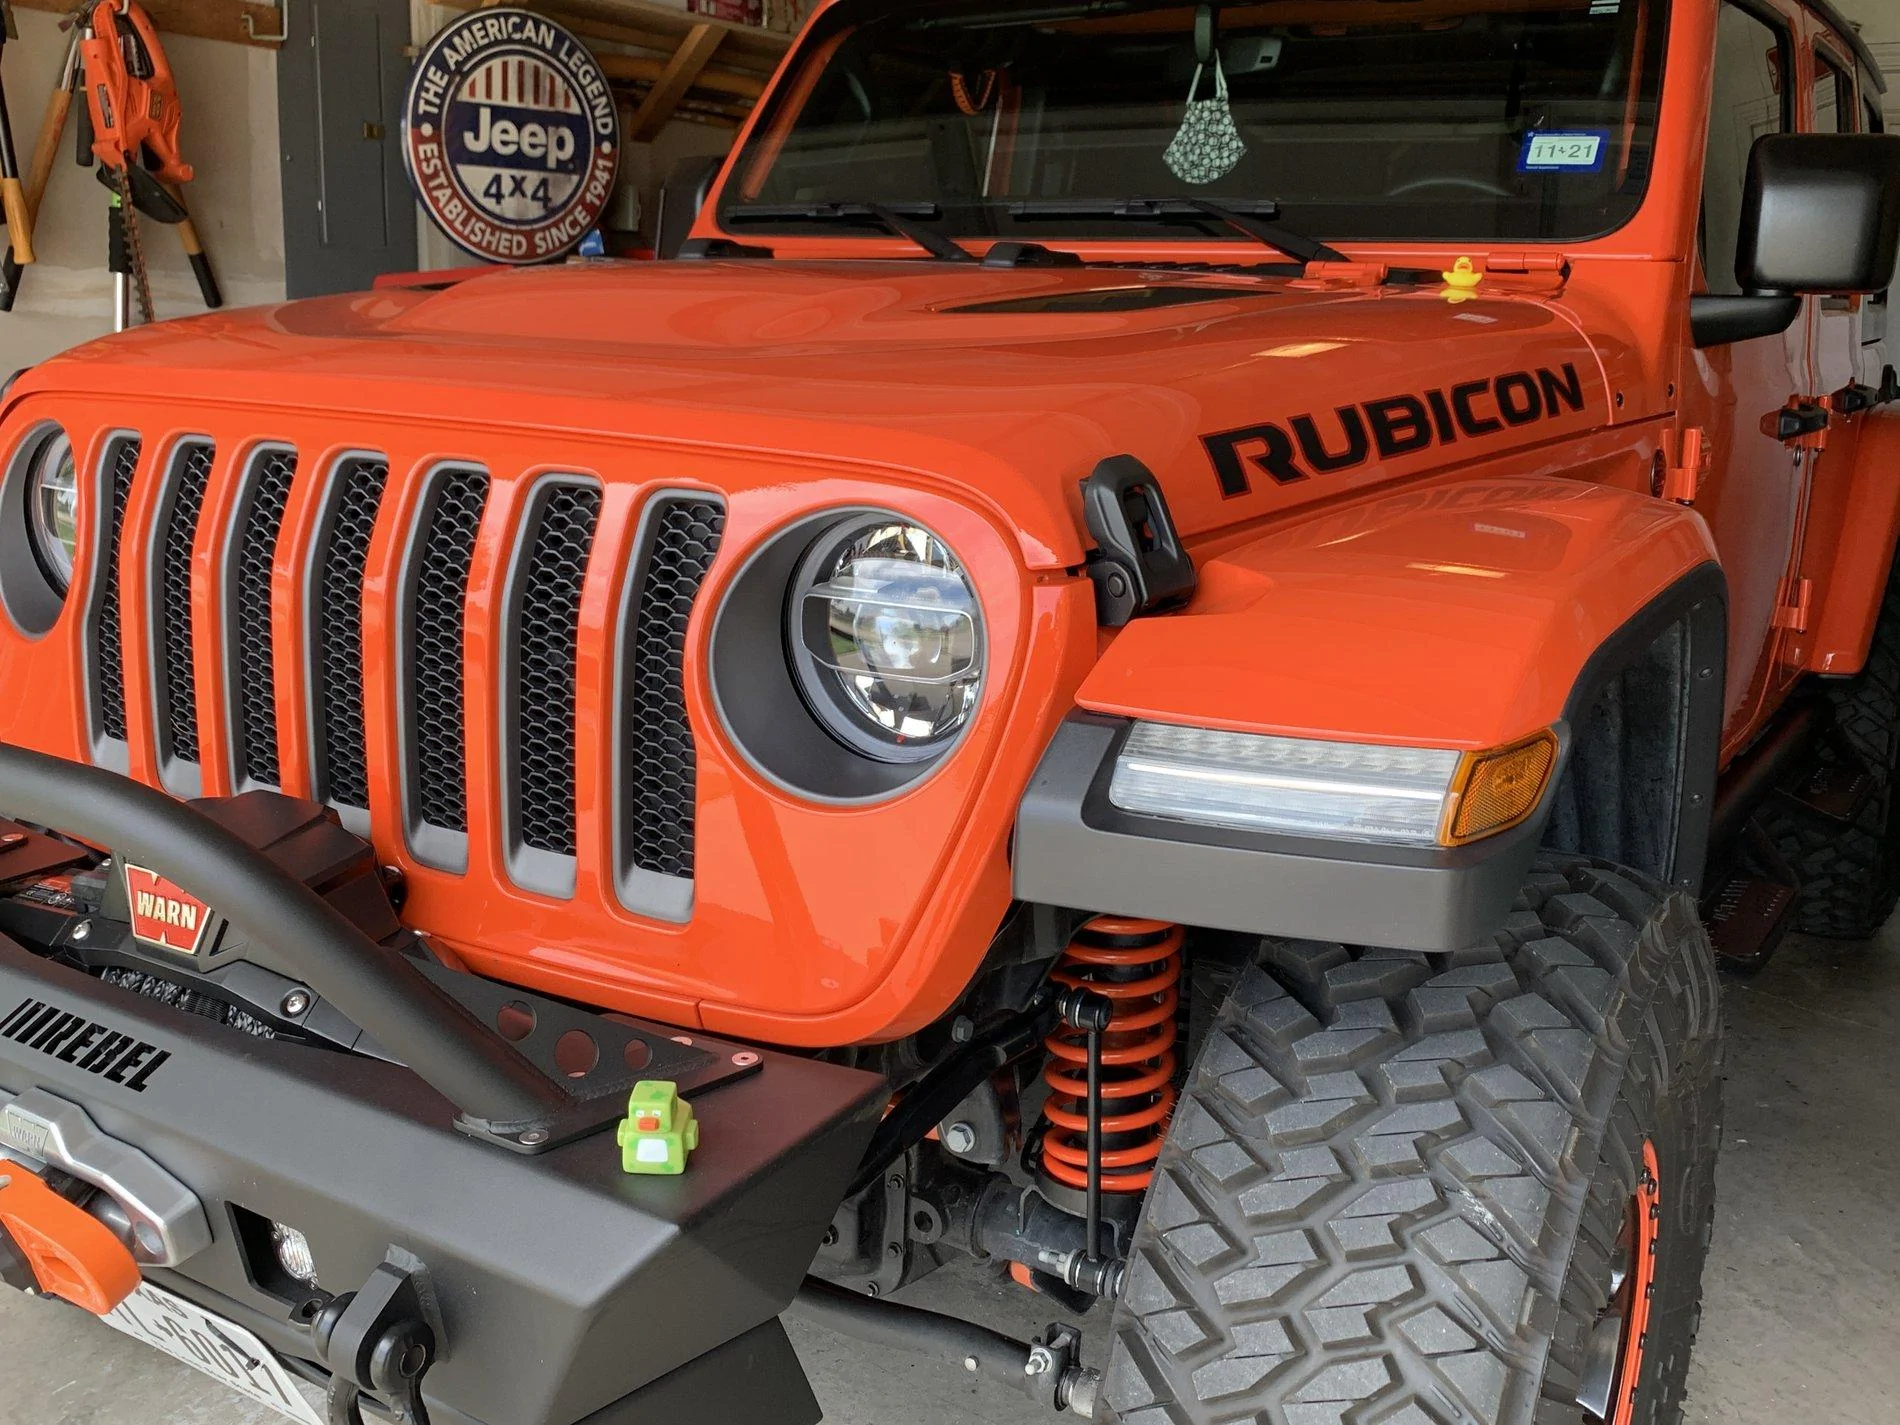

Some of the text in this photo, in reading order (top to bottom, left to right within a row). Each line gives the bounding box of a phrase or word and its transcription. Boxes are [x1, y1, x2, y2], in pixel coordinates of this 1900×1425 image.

[418, 15, 613, 135] THE AMERICAN LEGEND
[463, 107, 575, 170] Jeep
[419, 143, 614, 256] ESTABLISHED SINCE 1941
[1198, 363, 1584, 500] RUBICON
[136, 889, 198, 931] WARN
